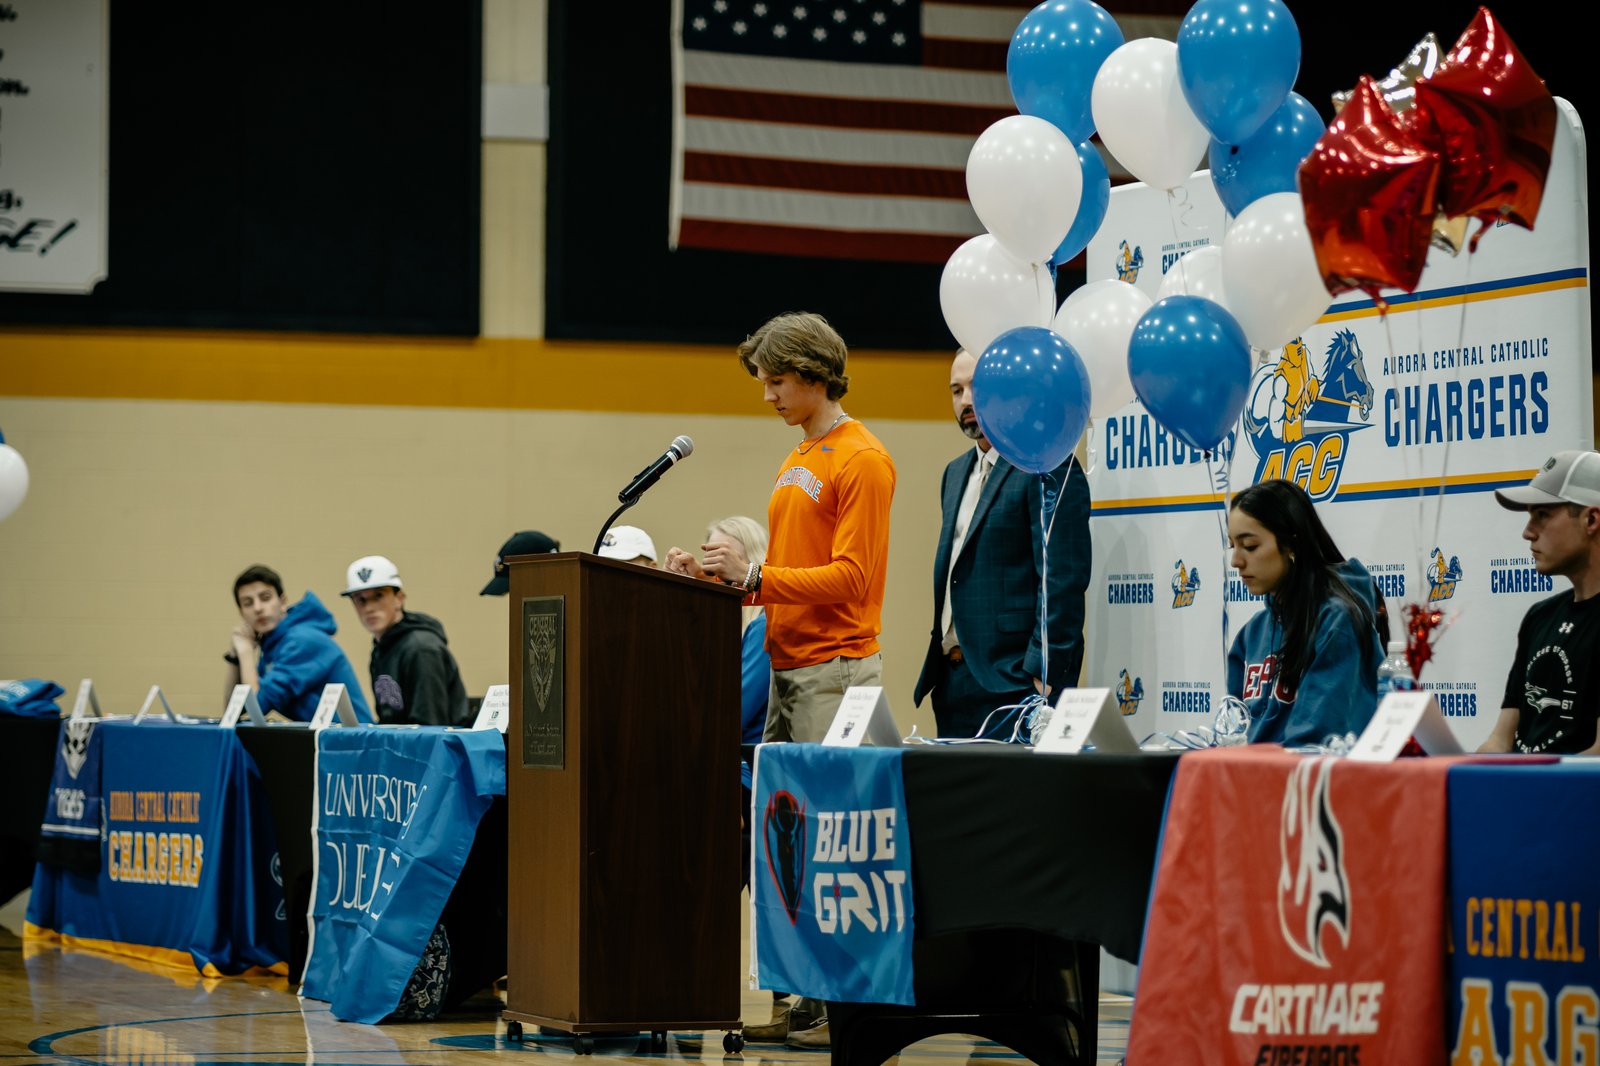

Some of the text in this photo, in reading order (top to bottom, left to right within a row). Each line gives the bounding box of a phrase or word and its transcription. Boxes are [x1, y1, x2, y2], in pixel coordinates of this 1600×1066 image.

[1383, 337, 1549, 376] AURORA CENTRAL CATHOLIC
[1385, 371, 1549, 448] CHARGERS
[1258, 433, 1344, 499] ACC
[1108, 583, 1154, 604] CHARGERS
[1491, 568, 1553, 593] CHARGERS
[1162, 691, 1211, 713] CHARGERS
[1561, 699, 1574, 710] 67
[108, 830, 204, 888] CHARGERS
[812, 807, 896, 864] BLUE
[813, 870, 906, 935] GRIT
[1466, 897, 1585, 963] CENTRAL
